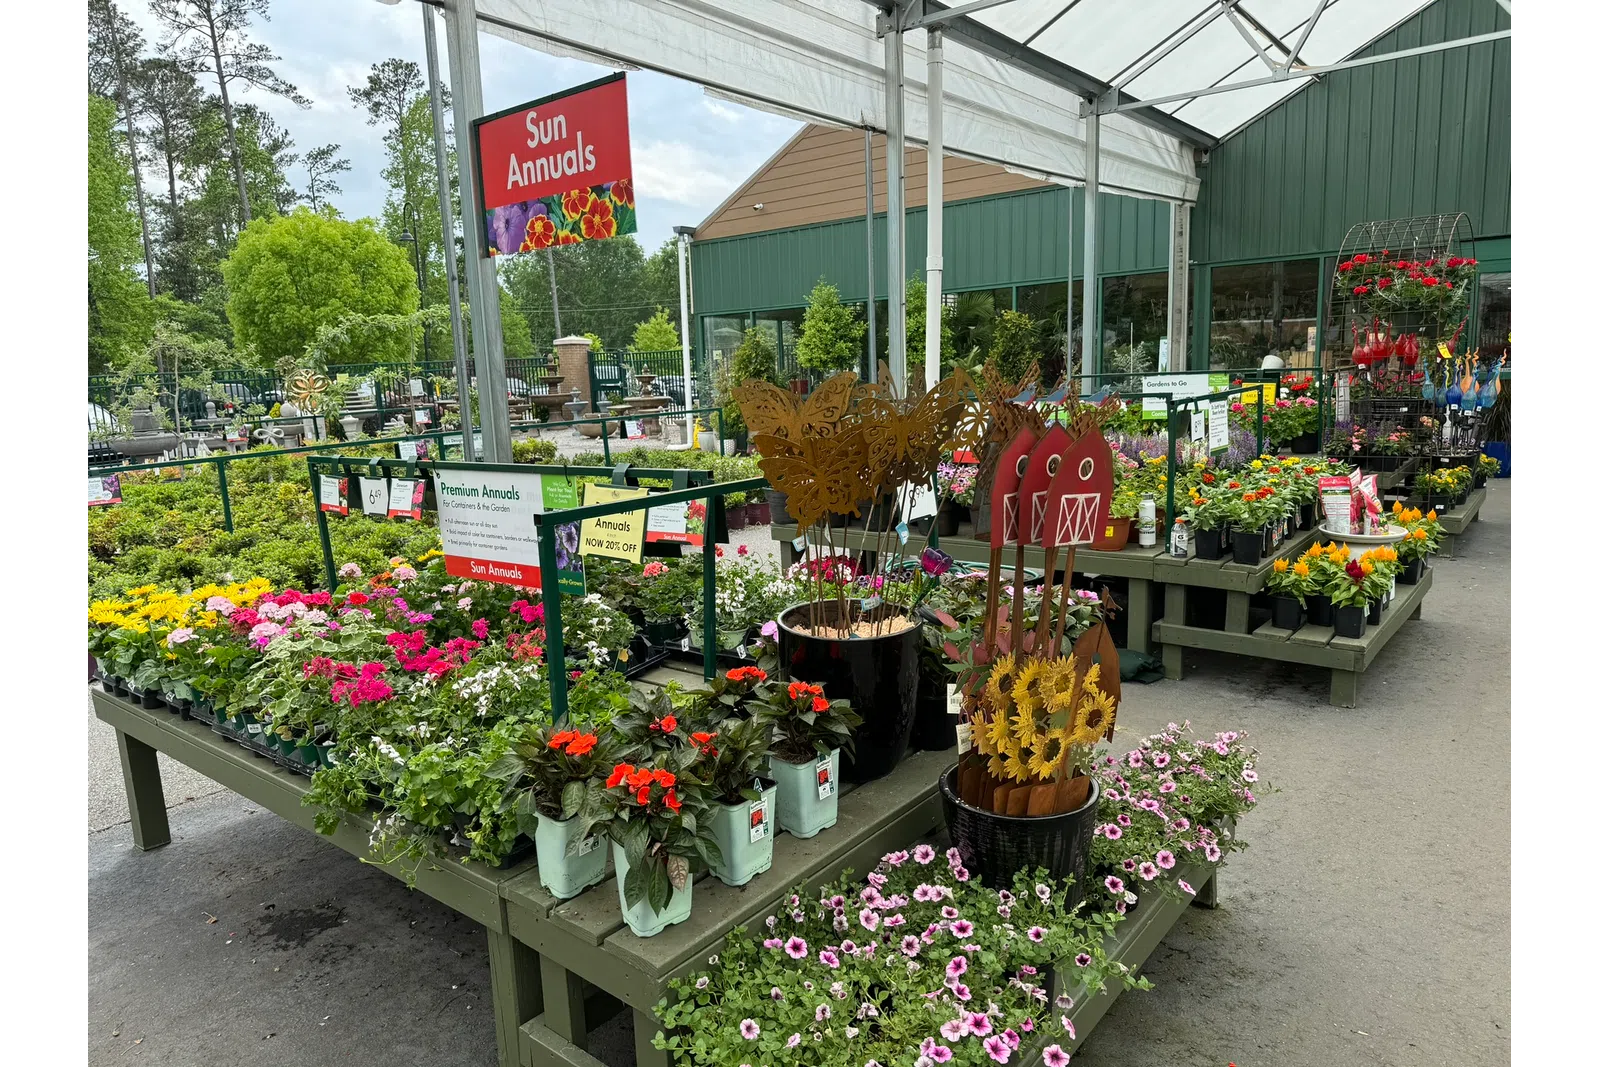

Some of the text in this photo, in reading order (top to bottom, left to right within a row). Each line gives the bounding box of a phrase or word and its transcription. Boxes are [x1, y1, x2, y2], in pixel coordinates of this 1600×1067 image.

[526, 110, 567, 149] Sun
[507, 130, 596, 190] Annuals
[440, 482, 520, 501] Premium Annuals
[451, 500, 476, 510] Containers
[477, 502, 481, 510] &
[482, 502, 490, 511] the
[491, 503, 510, 513] Garden
[595, 518, 631, 532] Annuals
[585, 538, 637, 553] NOW 20% OFF
[470, 560, 523, 579] Sun Annuals
